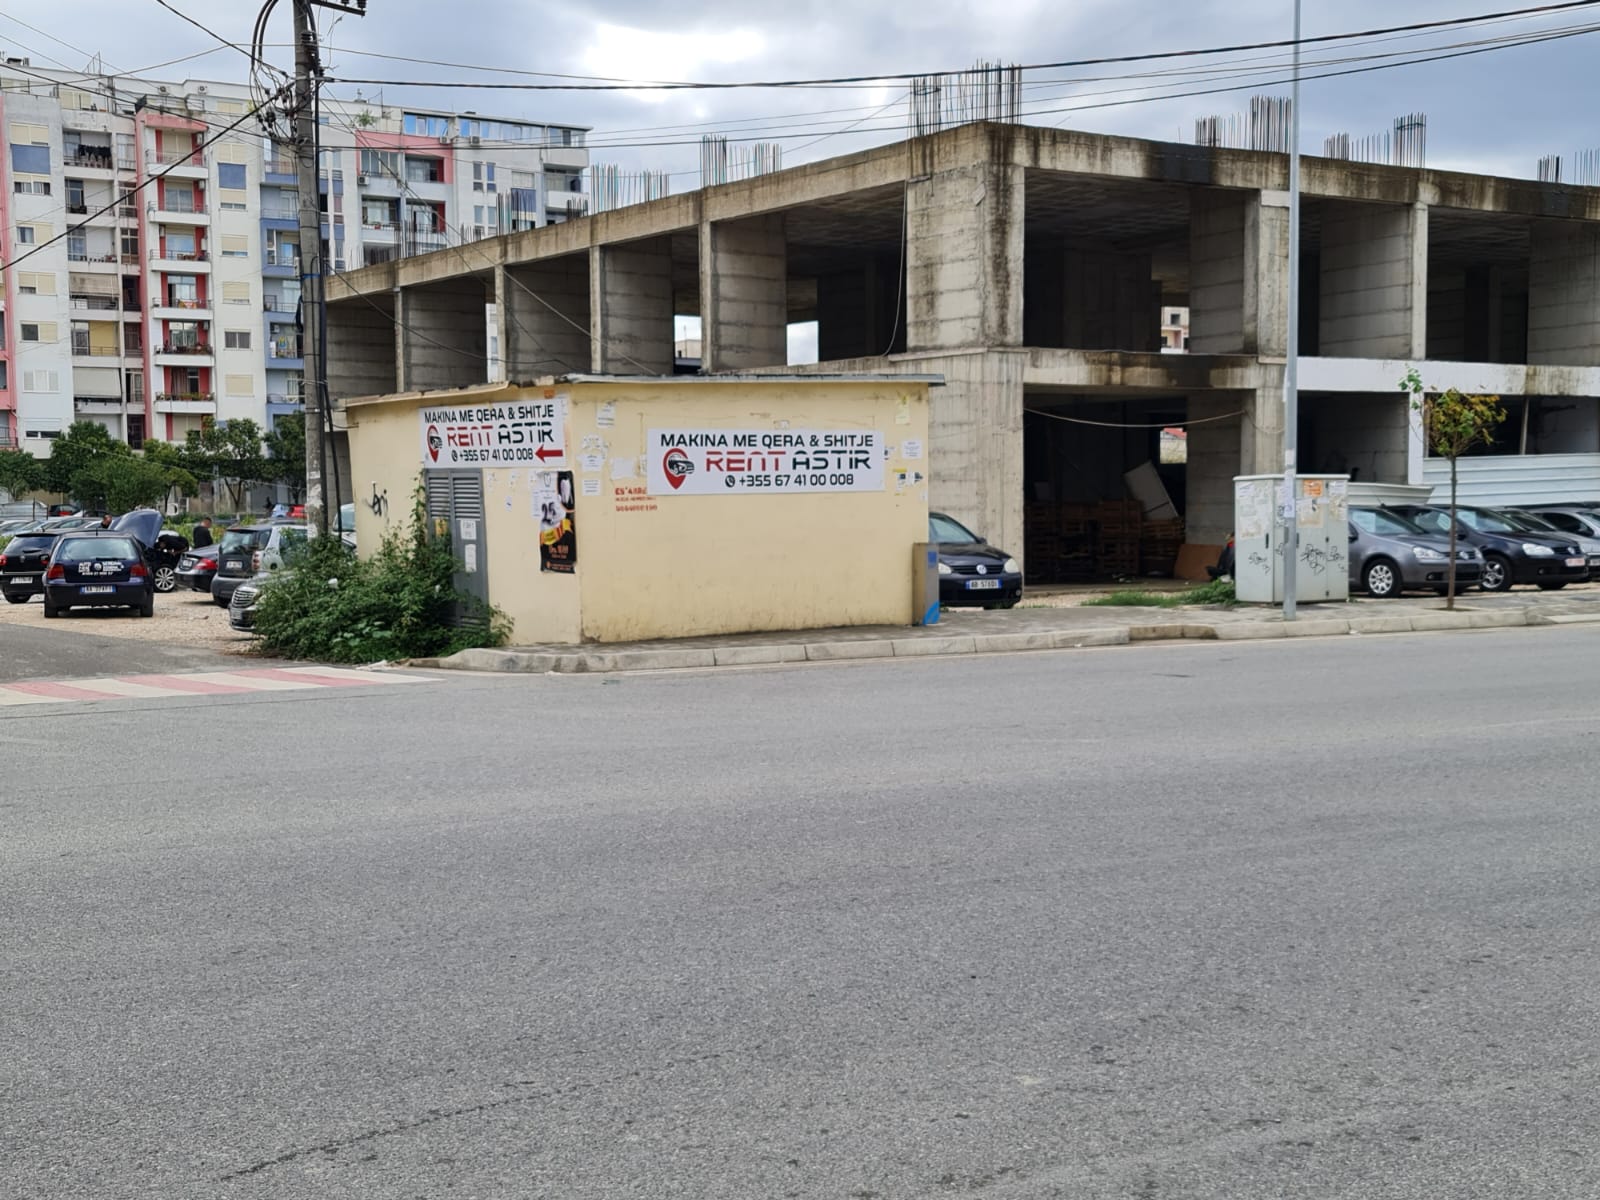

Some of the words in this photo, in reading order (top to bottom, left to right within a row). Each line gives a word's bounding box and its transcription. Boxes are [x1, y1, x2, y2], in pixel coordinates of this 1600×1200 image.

[424, 411, 458, 424] MAKINA
[459, 409, 474, 422] ME
[476, 407, 506, 423] QERA
[508, 406, 516, 420] &
[518, 404, 554, 419] SHITJE
[446, 425, 493, 447] RENT
[498, 421, 554, 444] ASTIR
[660, 433, 728, 447] MAKINA
[733, 434, 757, 447] ME
[761, 434, 804, 449] QERA
[808, 435, 820, 447] &
[823, 434, 873, 447] SHITJE
[459, 449, 479, 462] +355
[479, 449, 490, 461] 67
[491, 449, 501, 461] 41
[502, 448, 514, 461] 00
[516, 448, 534, 460] 008
[706, 450, 786, 472] RENT
[792, 449, 872, 470] ASTIR
[739, 474, 771, 487] +355
[775, 474, 791, 487] 67
[793, 474, 807, 487] 41
[809, 473, 826, 486] 00
[829, 473, 854, 485] 008
